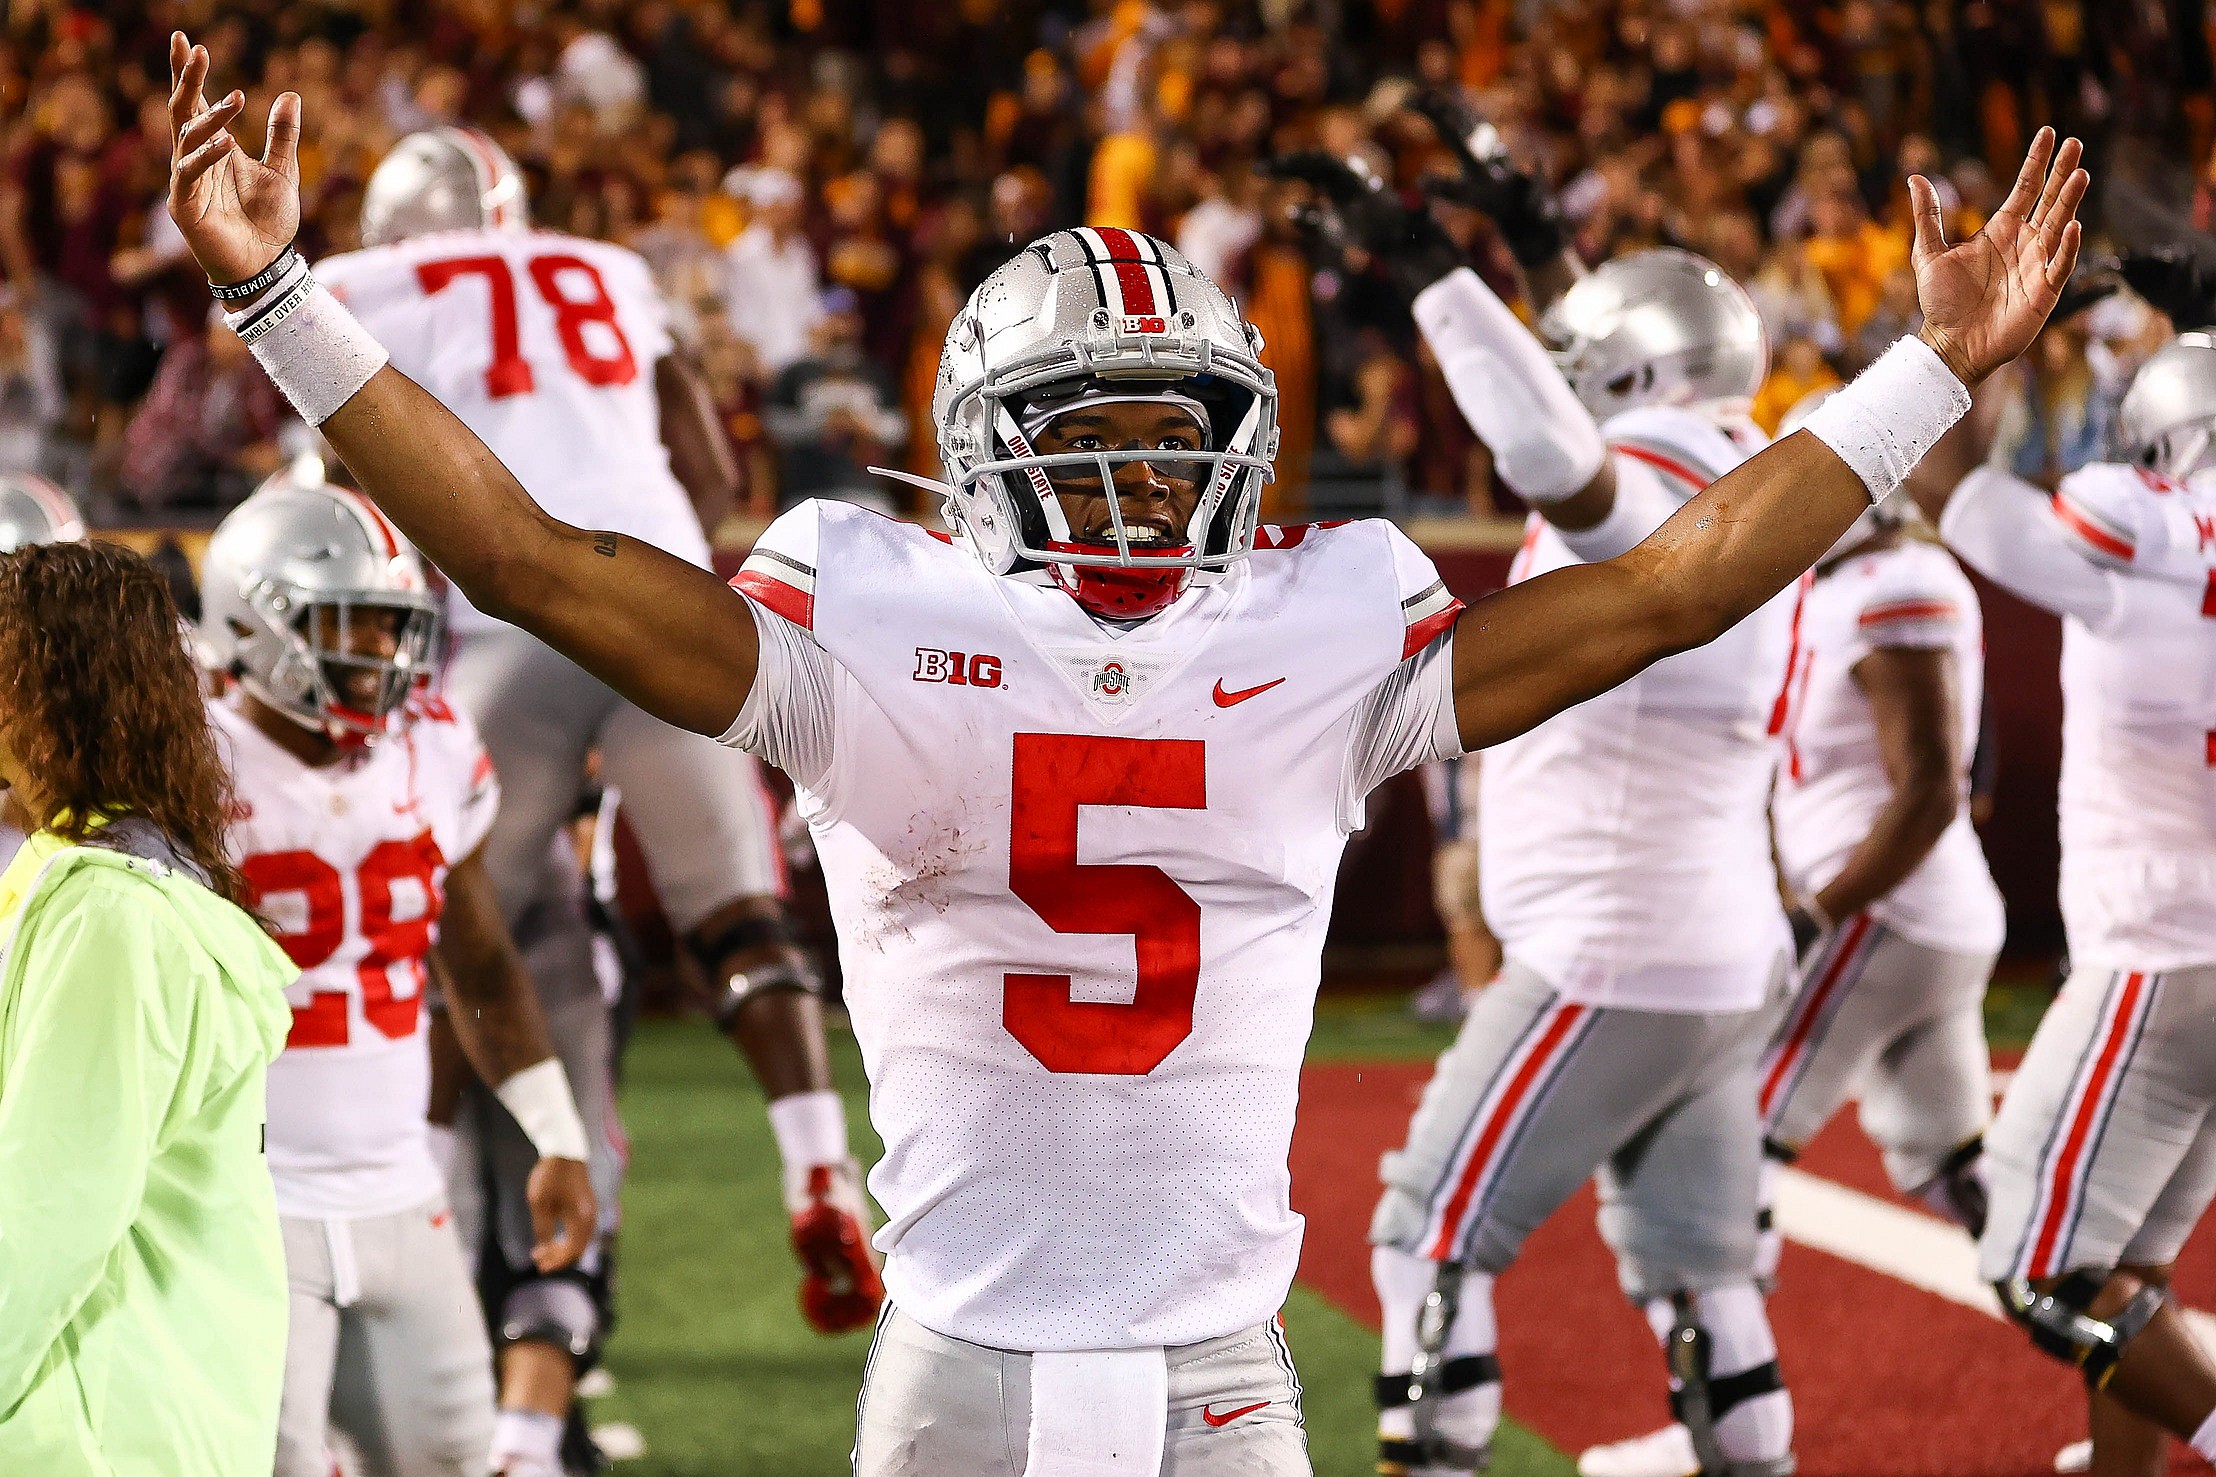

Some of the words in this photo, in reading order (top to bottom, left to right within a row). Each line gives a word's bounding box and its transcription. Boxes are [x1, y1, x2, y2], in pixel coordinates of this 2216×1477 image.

[225, 271, 274, 299] HUMBLE
[241, 317, 275, 343] UMBLE
[274, 293, 303, 320] OVER
[416, 255, 636, 400] 78
[1027, 466, 1054, 502] STATE
[235, 826, 447, 1049] 28
[1002, 731, 1208, 1076] 5
